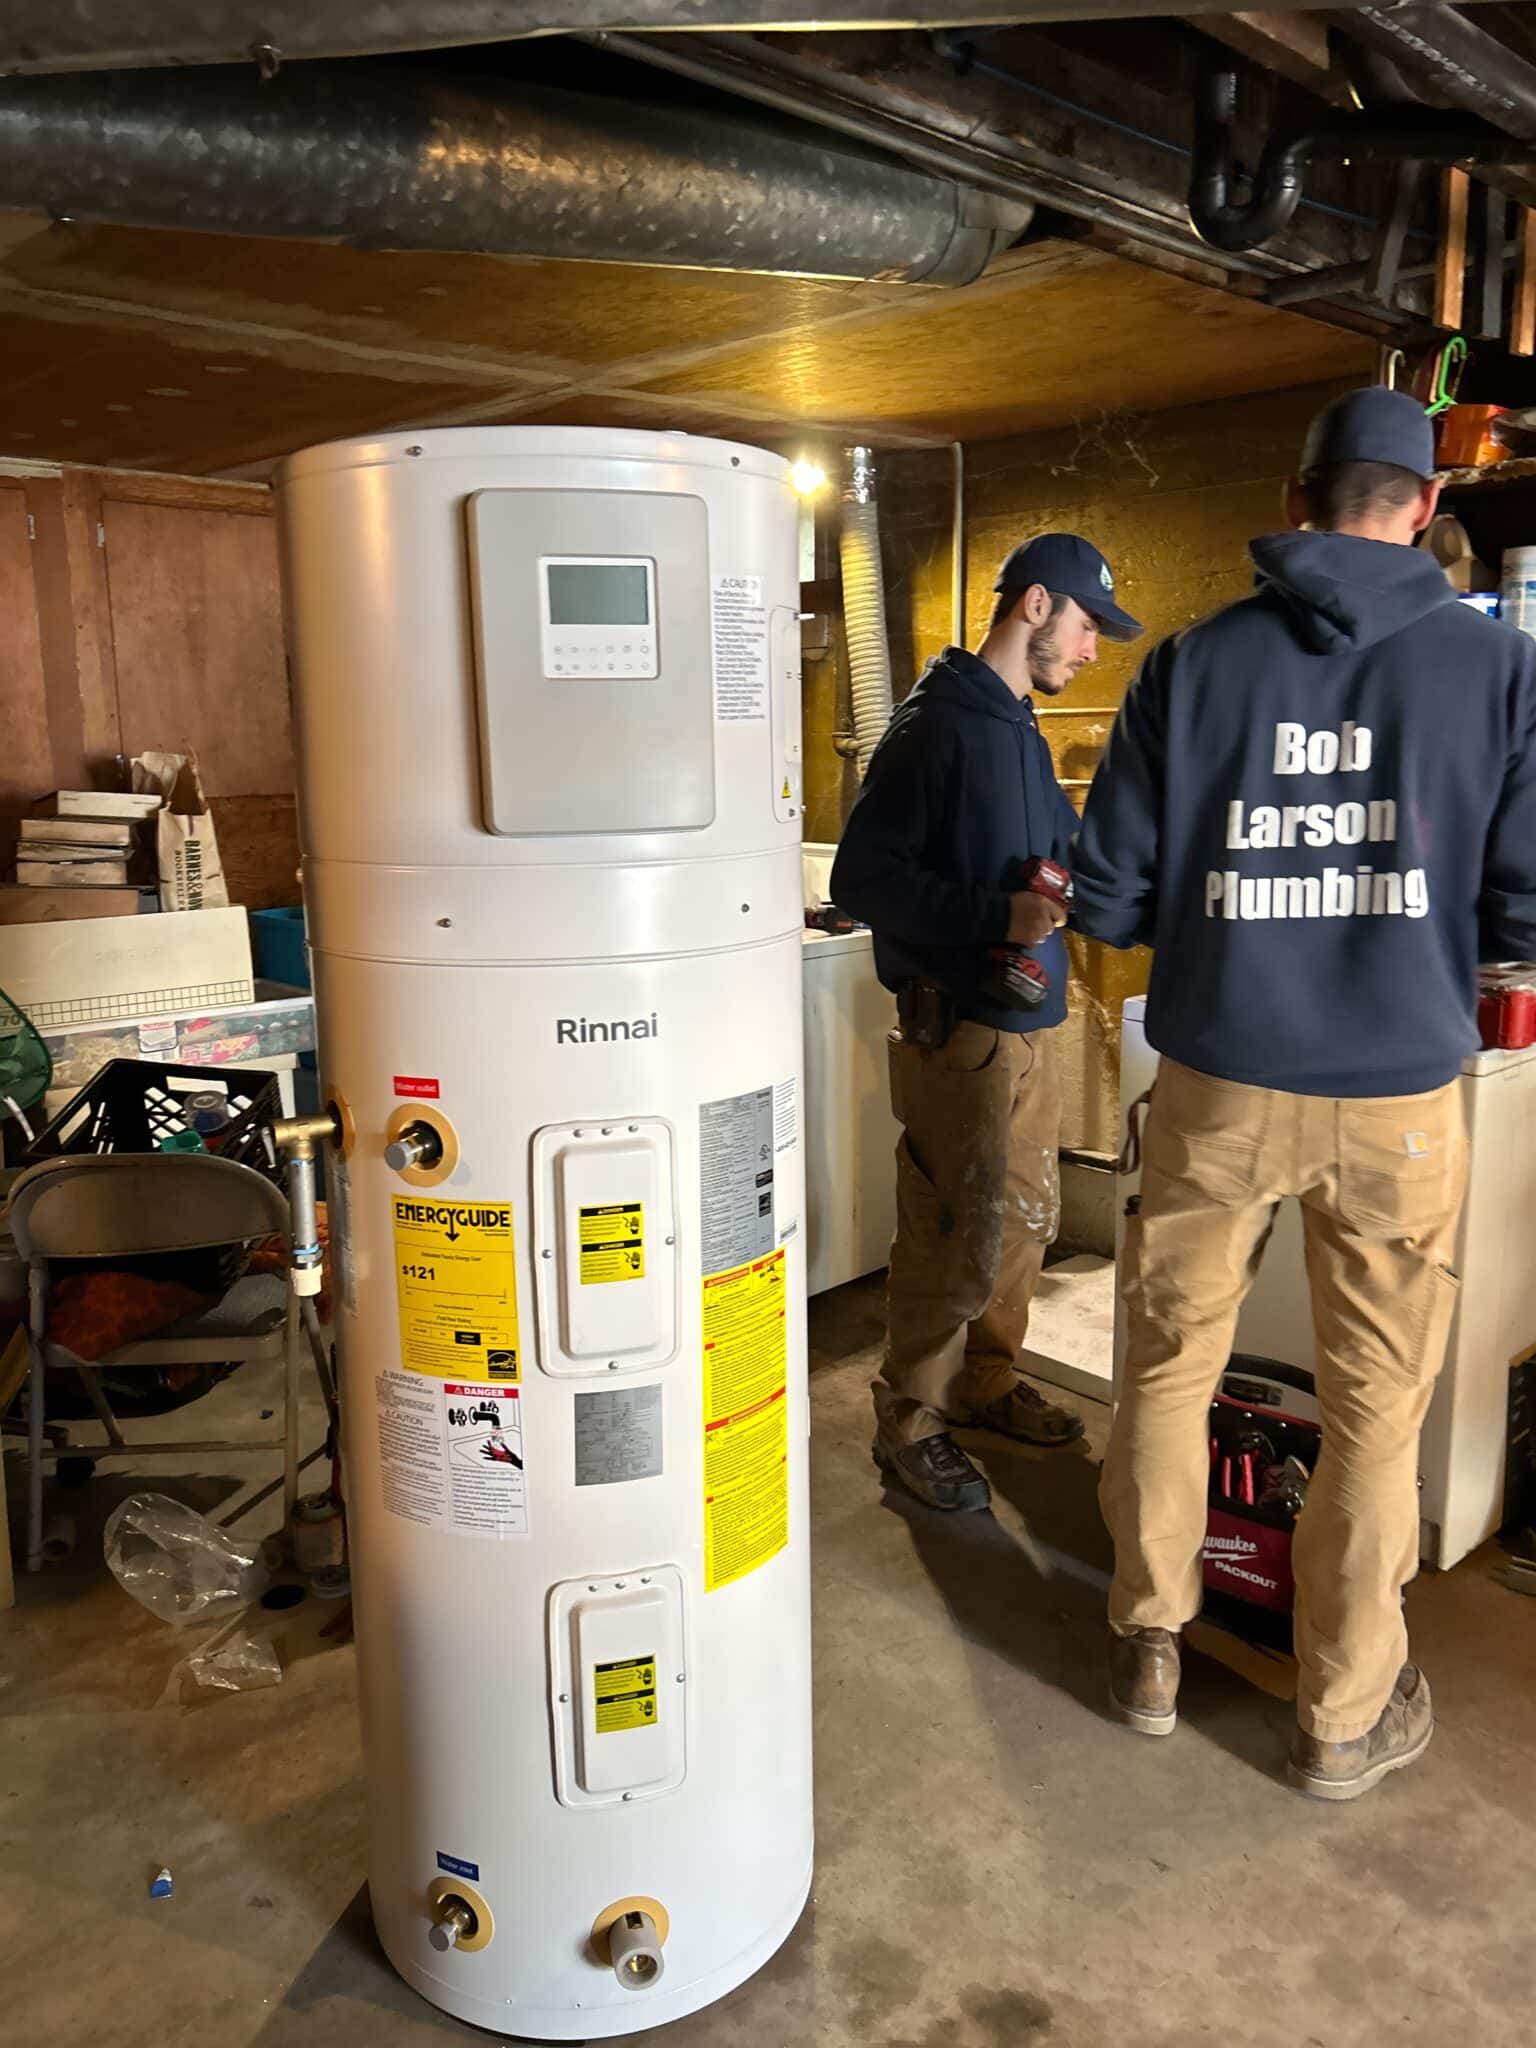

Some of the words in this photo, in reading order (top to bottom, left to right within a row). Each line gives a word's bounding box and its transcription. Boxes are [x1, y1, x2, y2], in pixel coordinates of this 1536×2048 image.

[1272, 721, 1373, 775] Bob
[1226, 799, 1397, 849] Larson
[1205, 865, 1430, 920] Plumbing
[556, 1012, 658, 1044] Rinnai
[396, 1202, 511, 1228] ENERGYGUIDE
[402, 1265, 435, 1281] $121
[463, 1387, 505, 1398] DANGER
[391, 1411, 424, 1426] CAUTION
[1203, 1534, 1258, 1553] waukee
[1214, 1560, 1279, 1590] PACKOUT
